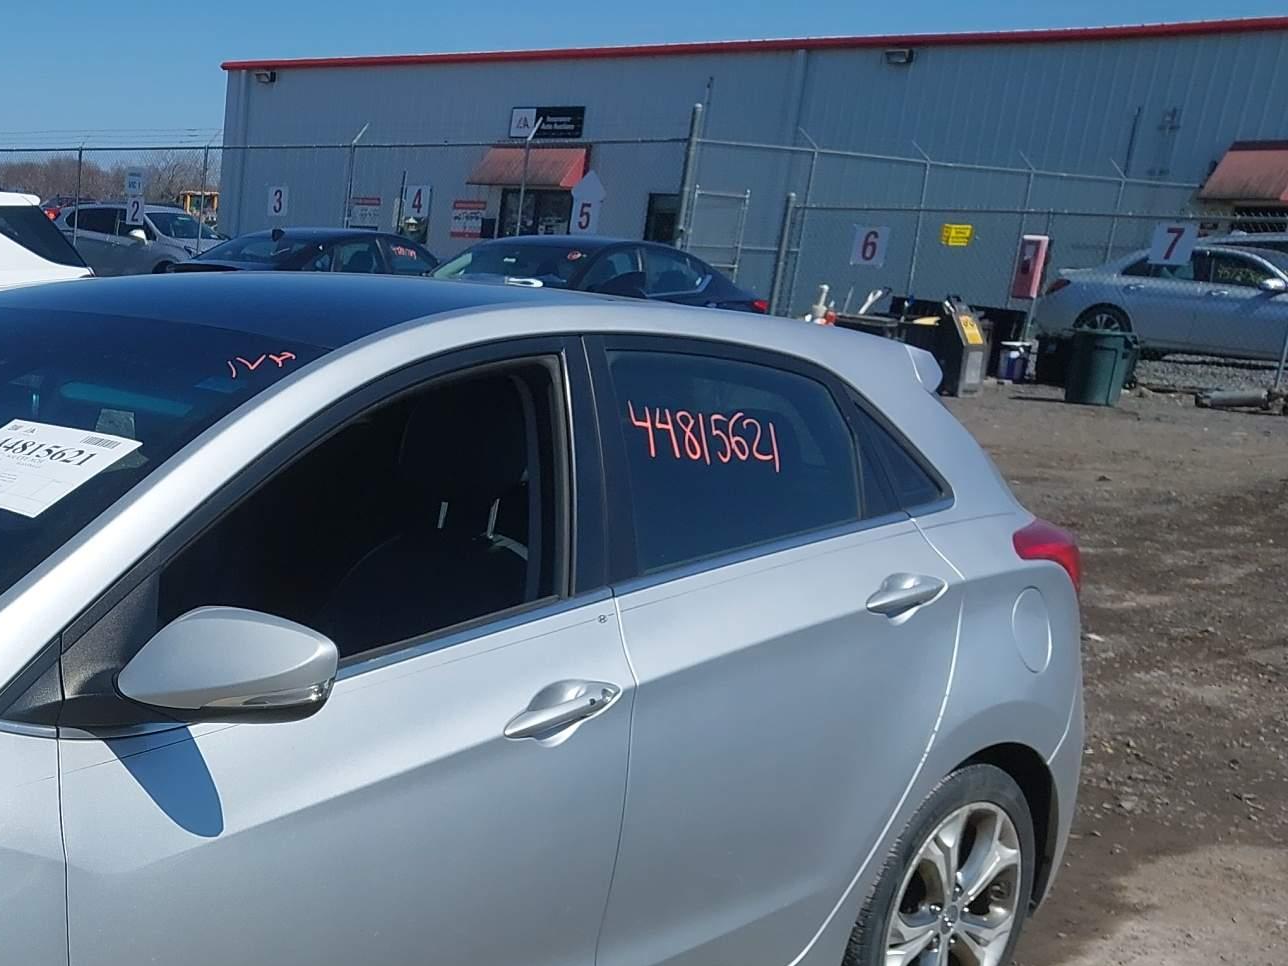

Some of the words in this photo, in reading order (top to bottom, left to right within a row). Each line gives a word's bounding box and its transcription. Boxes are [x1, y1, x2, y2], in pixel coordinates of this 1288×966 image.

[130, 199, 140, 222] 2
[273, 188, 283, 214] 3
[412, 188, 422, 213] 4
[578, 203, 591, 230] 5
[861, 230, 879, 261] 6
[1165, 227, 1184, 260] 7
[627, 399, 781, 473] 44815621
